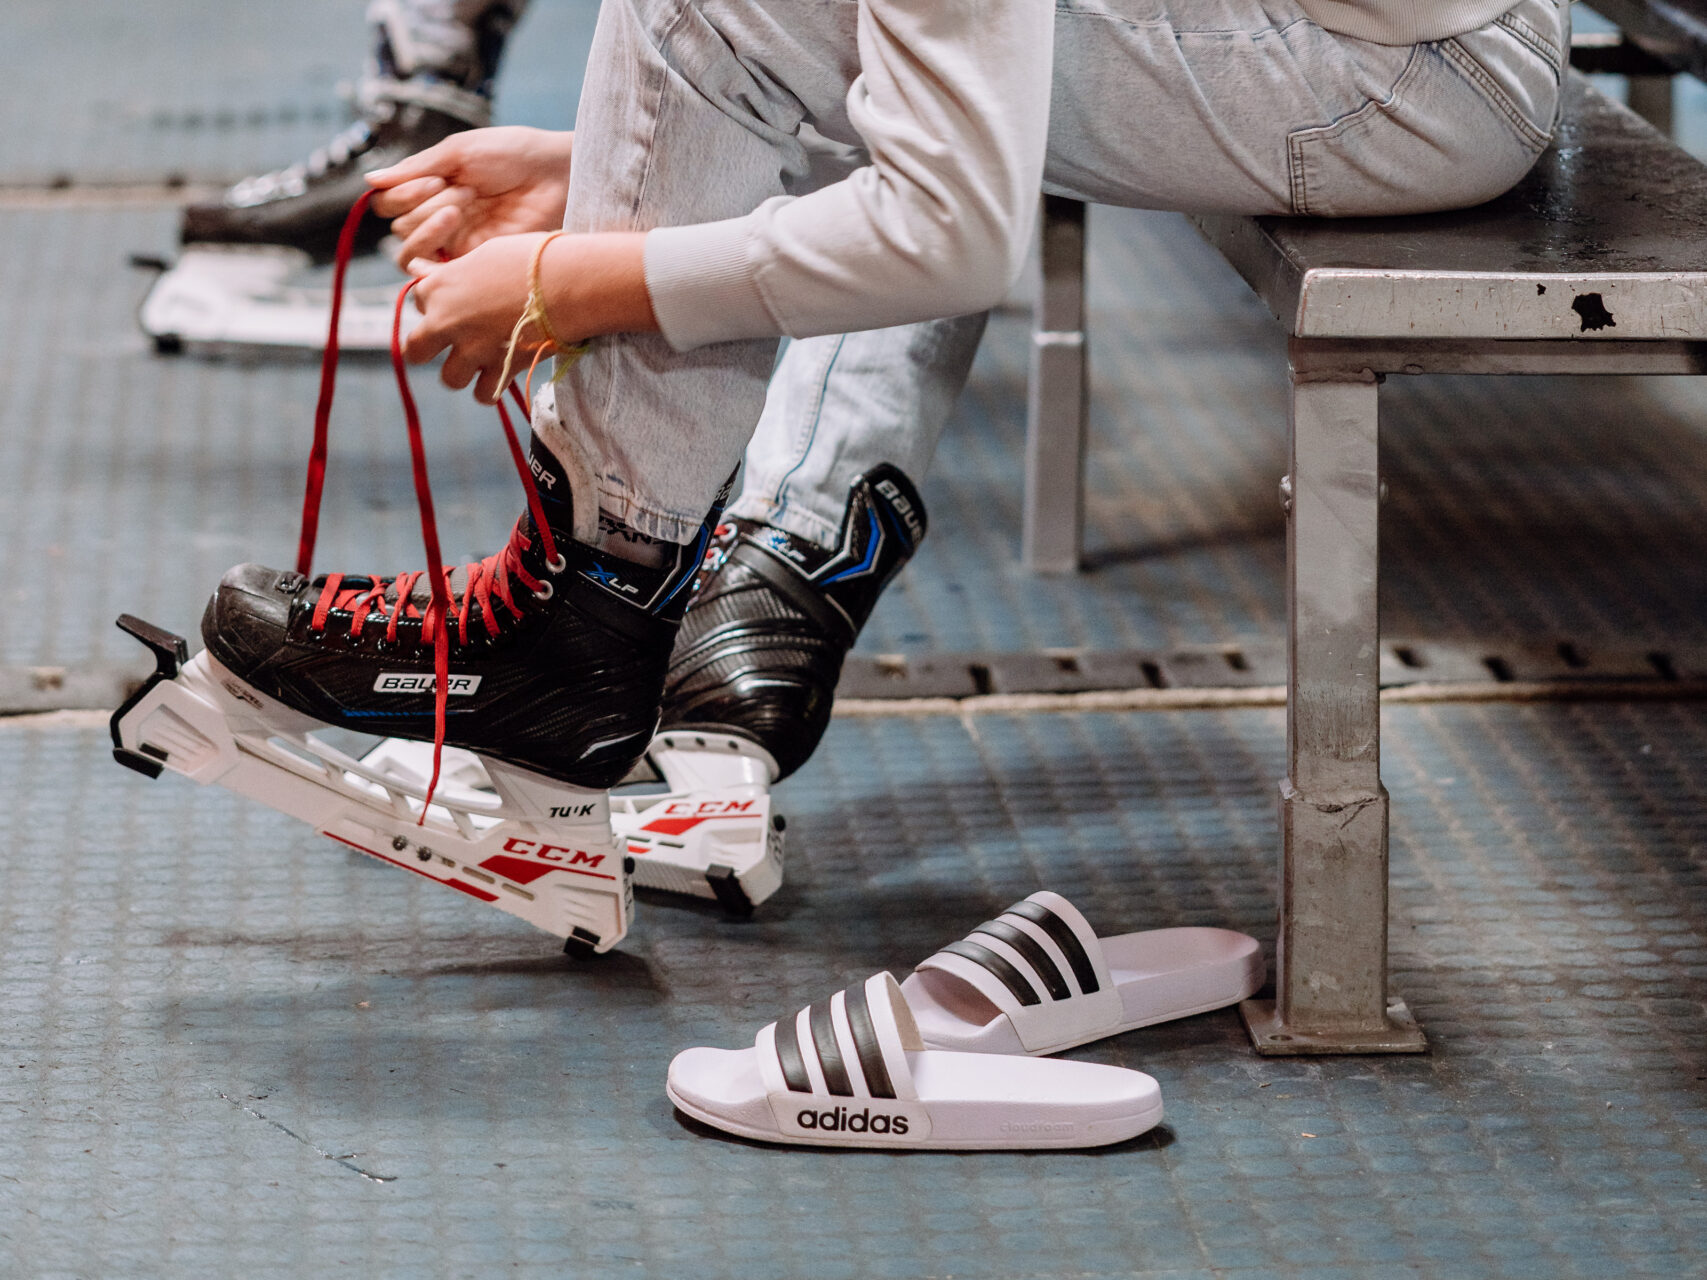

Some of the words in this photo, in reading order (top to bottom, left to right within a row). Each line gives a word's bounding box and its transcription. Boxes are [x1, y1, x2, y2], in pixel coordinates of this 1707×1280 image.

[665, 800, 755, 815] CCM
[503, 837, 606, 868] CCM
[797, 1106, 909, 1135] adidas
